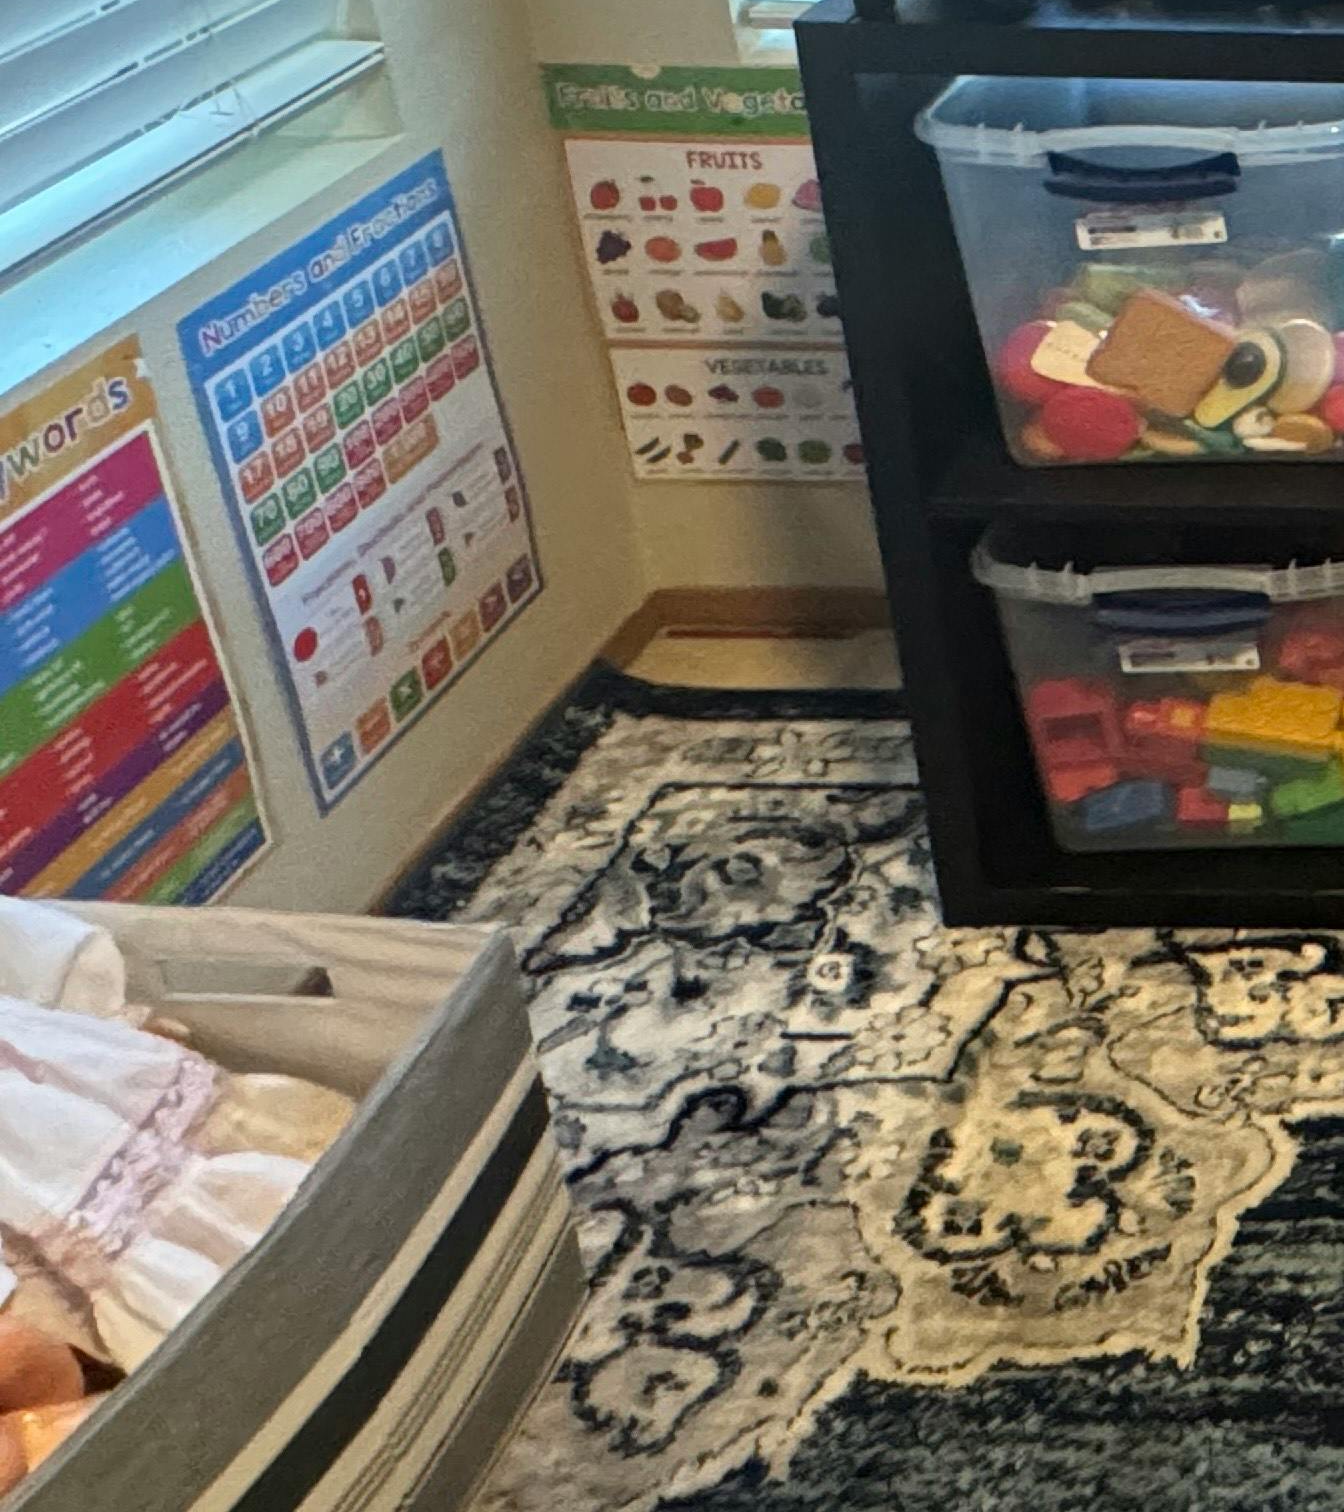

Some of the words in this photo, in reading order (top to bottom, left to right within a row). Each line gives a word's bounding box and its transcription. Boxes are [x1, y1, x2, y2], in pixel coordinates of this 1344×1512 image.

[645, 84, 699, 112] and
[686, 150, 763, 170] FRUITS
[200, 271, 308, 356] Numbers
[309, 236, 350, 283] and
[225, 379, 236, 398] 1
[261, 354, 273, 376] 2
[322, 309, 333, 327] 4
[352, 288, 363, 307] 5
[705, 358, 828, 375] VEGETABLES
[266, 393, 287, 416] 10
[299, 371, 317, 393] 11
[243, 458, 261, 484] 17
